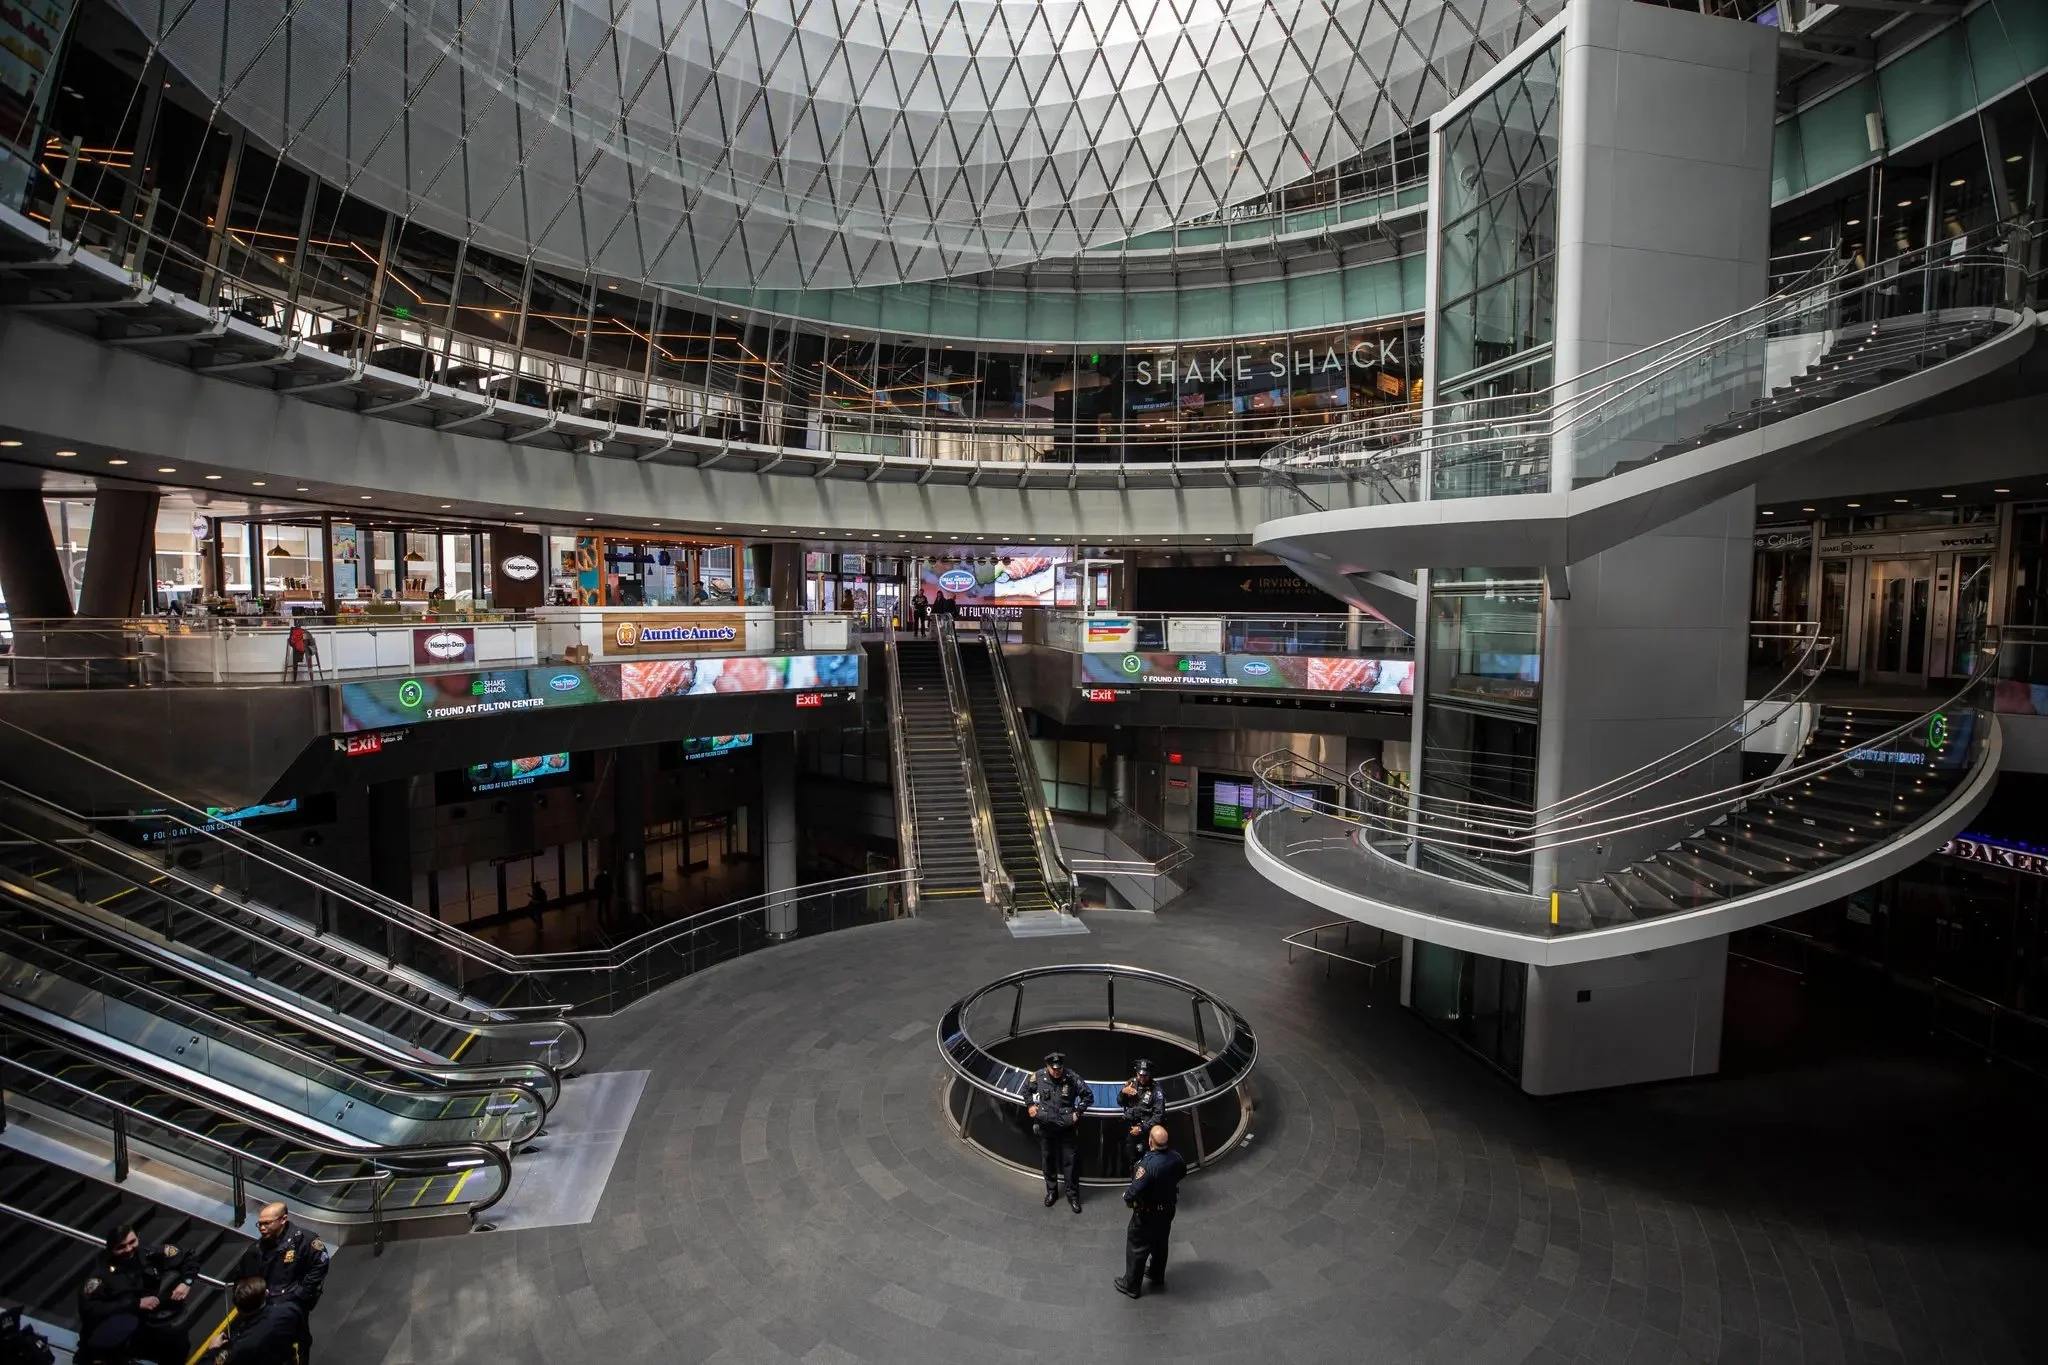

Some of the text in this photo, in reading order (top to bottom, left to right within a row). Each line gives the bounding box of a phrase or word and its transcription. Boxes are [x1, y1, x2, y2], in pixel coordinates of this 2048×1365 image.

[1136, 355, 1252, 385] SHAKE
[1269, 337, 1400, 378] SHACK
[1768, 533, 1803, 547] Cellar
[1941, 533, 1994, 546] wework
[1259, 577, 1300, 587] IRVING
[959, 607, 967, 616] AT
[969, 607, 994, 616] FULTON
[641, 625, 736, 640] Auntie Anne's
[484, 679, 505, 687] SHAKE
[1210, 677, 1238, 685] CENTER
[484, 686, 507, 694] SHACK
[1091, 690, 1111, 699] Exit
[796, 694, 818, 704] Exit
[435, 698, 544, 717] FOUND AT FULTON CENTER
[347, 735, 378, 753] Exit
[479, 783, 494, 791] FOUND
[501, 779, 517, 787] FULTON
[153, 829, 177, 840] FOUD
[179, 827, 187, 836] AT
[1956, 840, 2048, 876] BAKER
